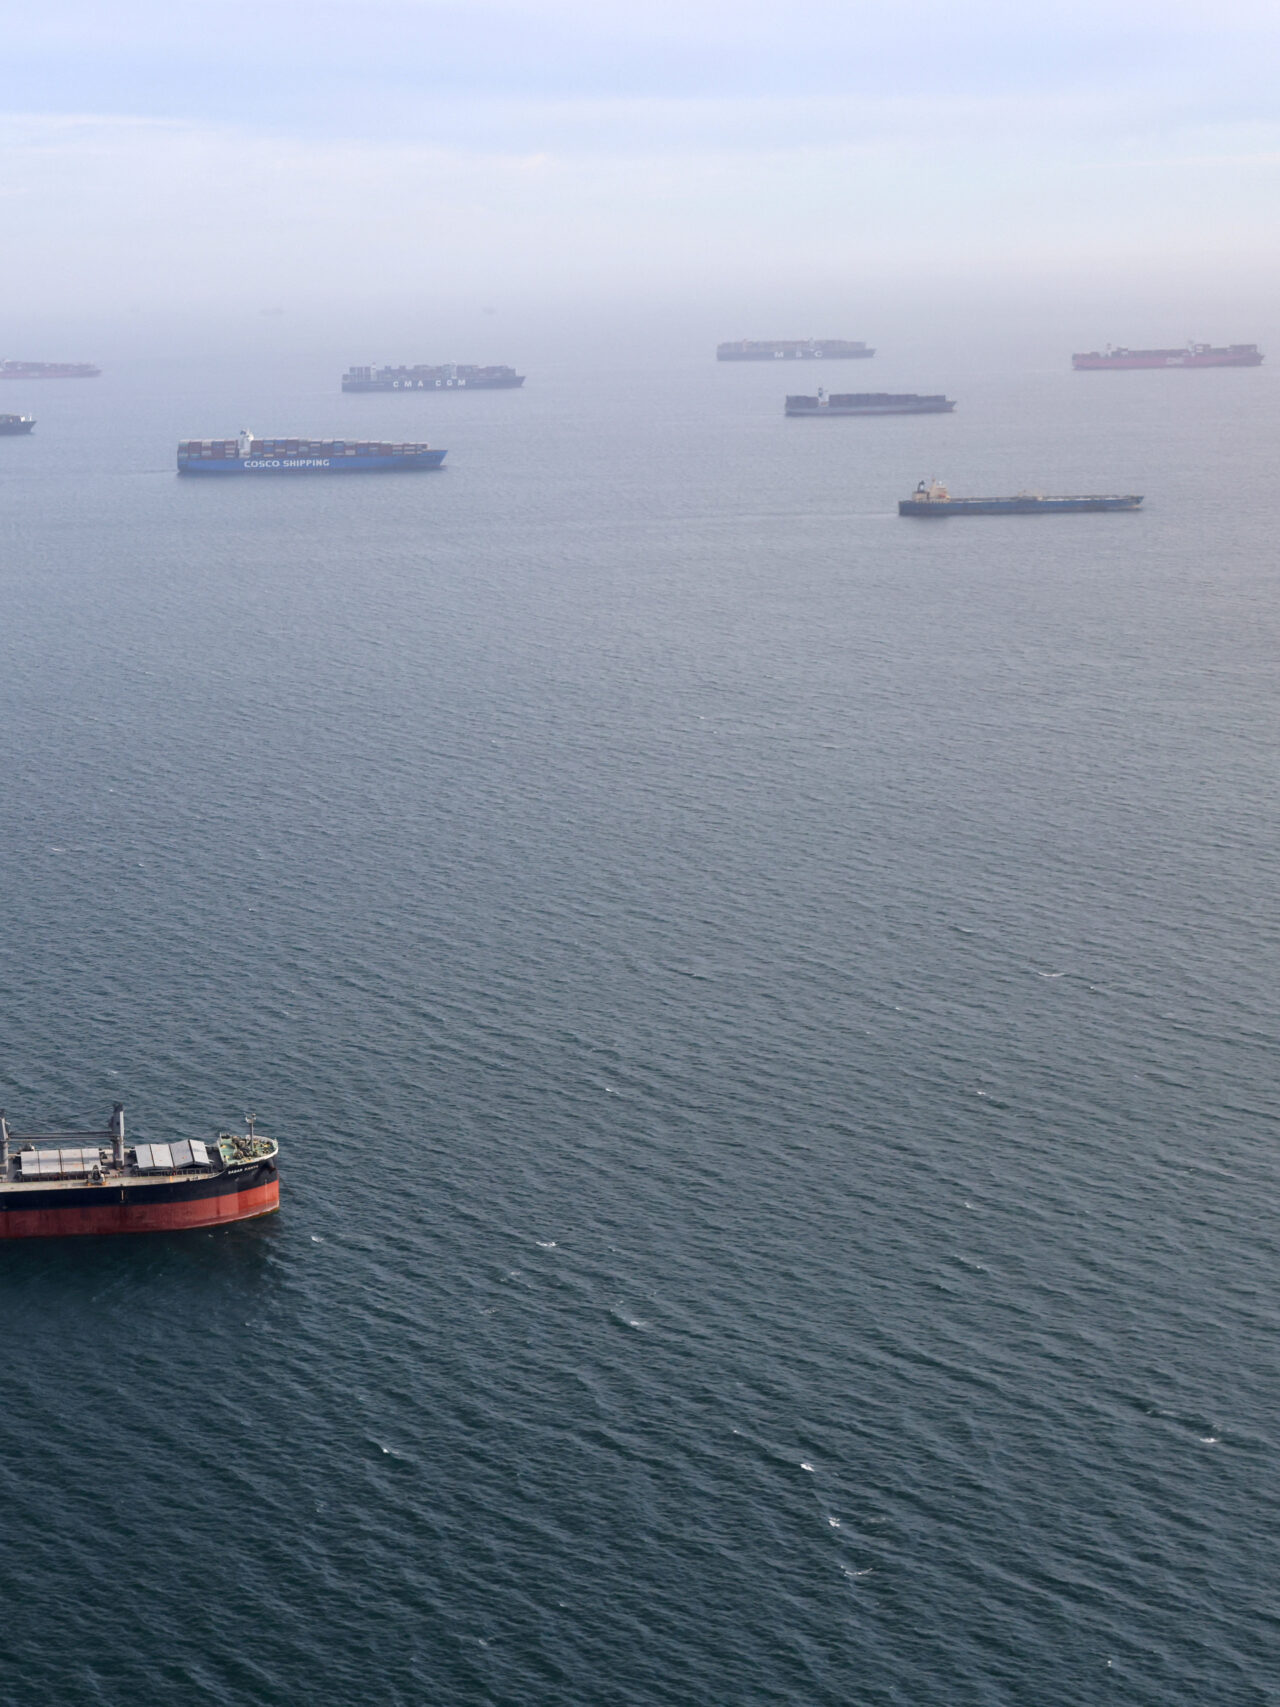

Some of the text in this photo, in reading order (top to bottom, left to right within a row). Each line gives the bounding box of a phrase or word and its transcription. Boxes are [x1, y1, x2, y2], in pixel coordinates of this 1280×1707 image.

[393, 380, 424, 388] CMA
[244, 459, 330, 468] COSCO SHIPPING
